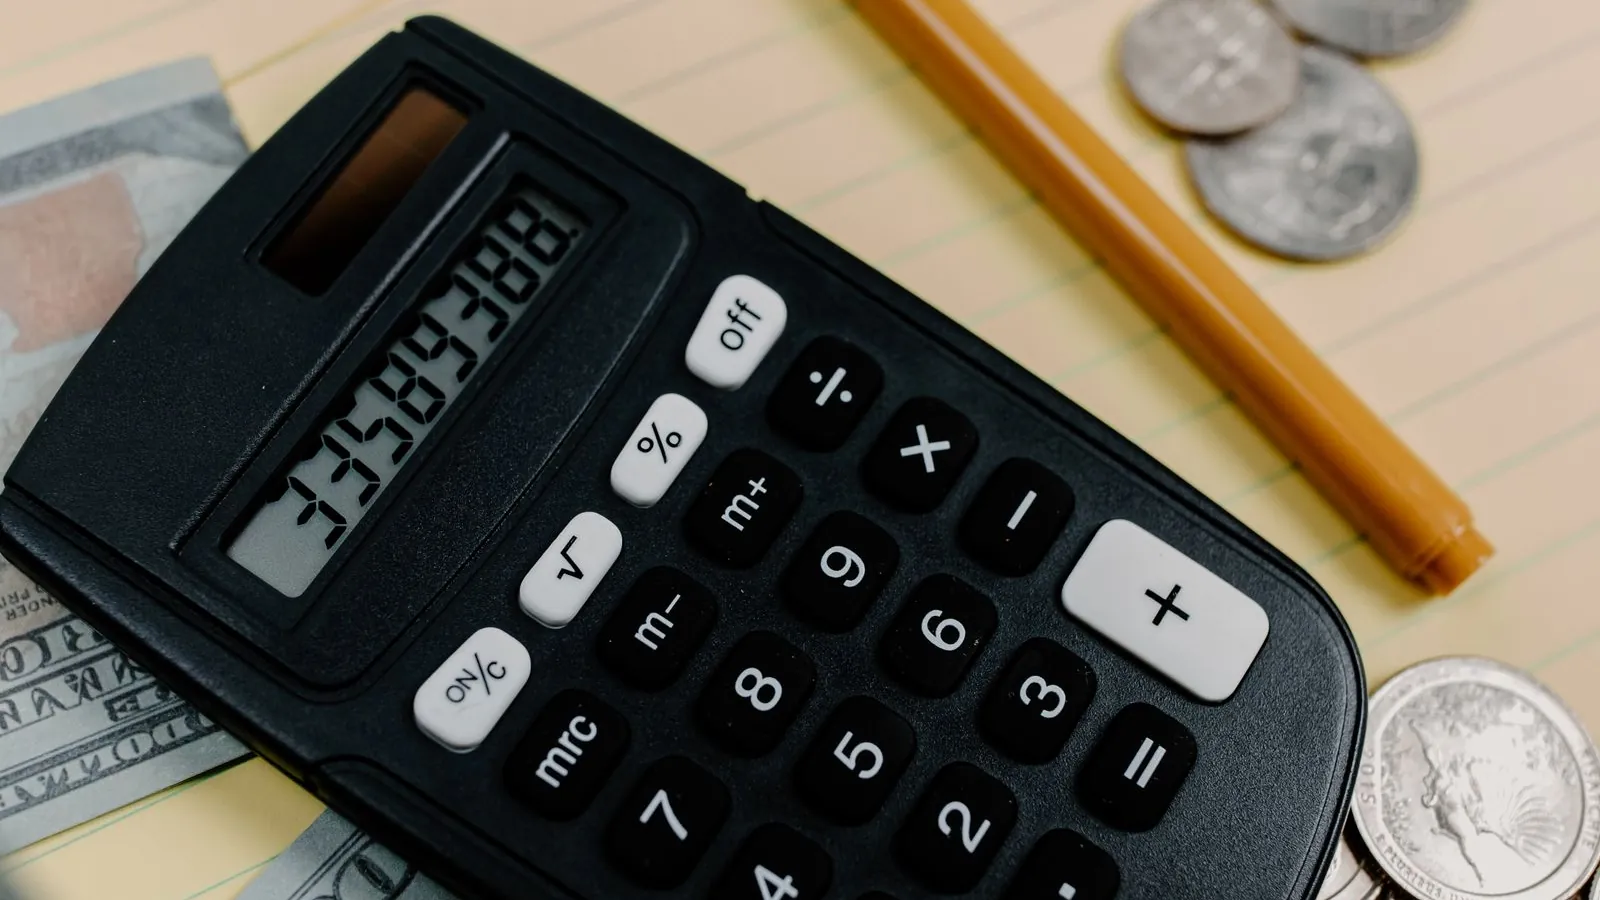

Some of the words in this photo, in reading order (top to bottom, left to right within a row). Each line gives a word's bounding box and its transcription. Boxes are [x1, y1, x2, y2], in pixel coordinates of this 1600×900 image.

[720, 297, 763, 351] off
[637, 421, 683, 464] %
[721, 477, 768, 532] m+
[820, 545, 866, 588] 9
[921, 609, 966, 651] 6
[445, 652, 507, 704] ON/C
[734, 667, 783, 712] 8
[1019, 675, 1066, 719] 3
[535, 715, 597, 788] mrc
[833, 731, 884, 779] 5
[639, 789, 688, 840] 7
[938, 801, 991, 853] 2
[754, 864, 799, 900] 4
